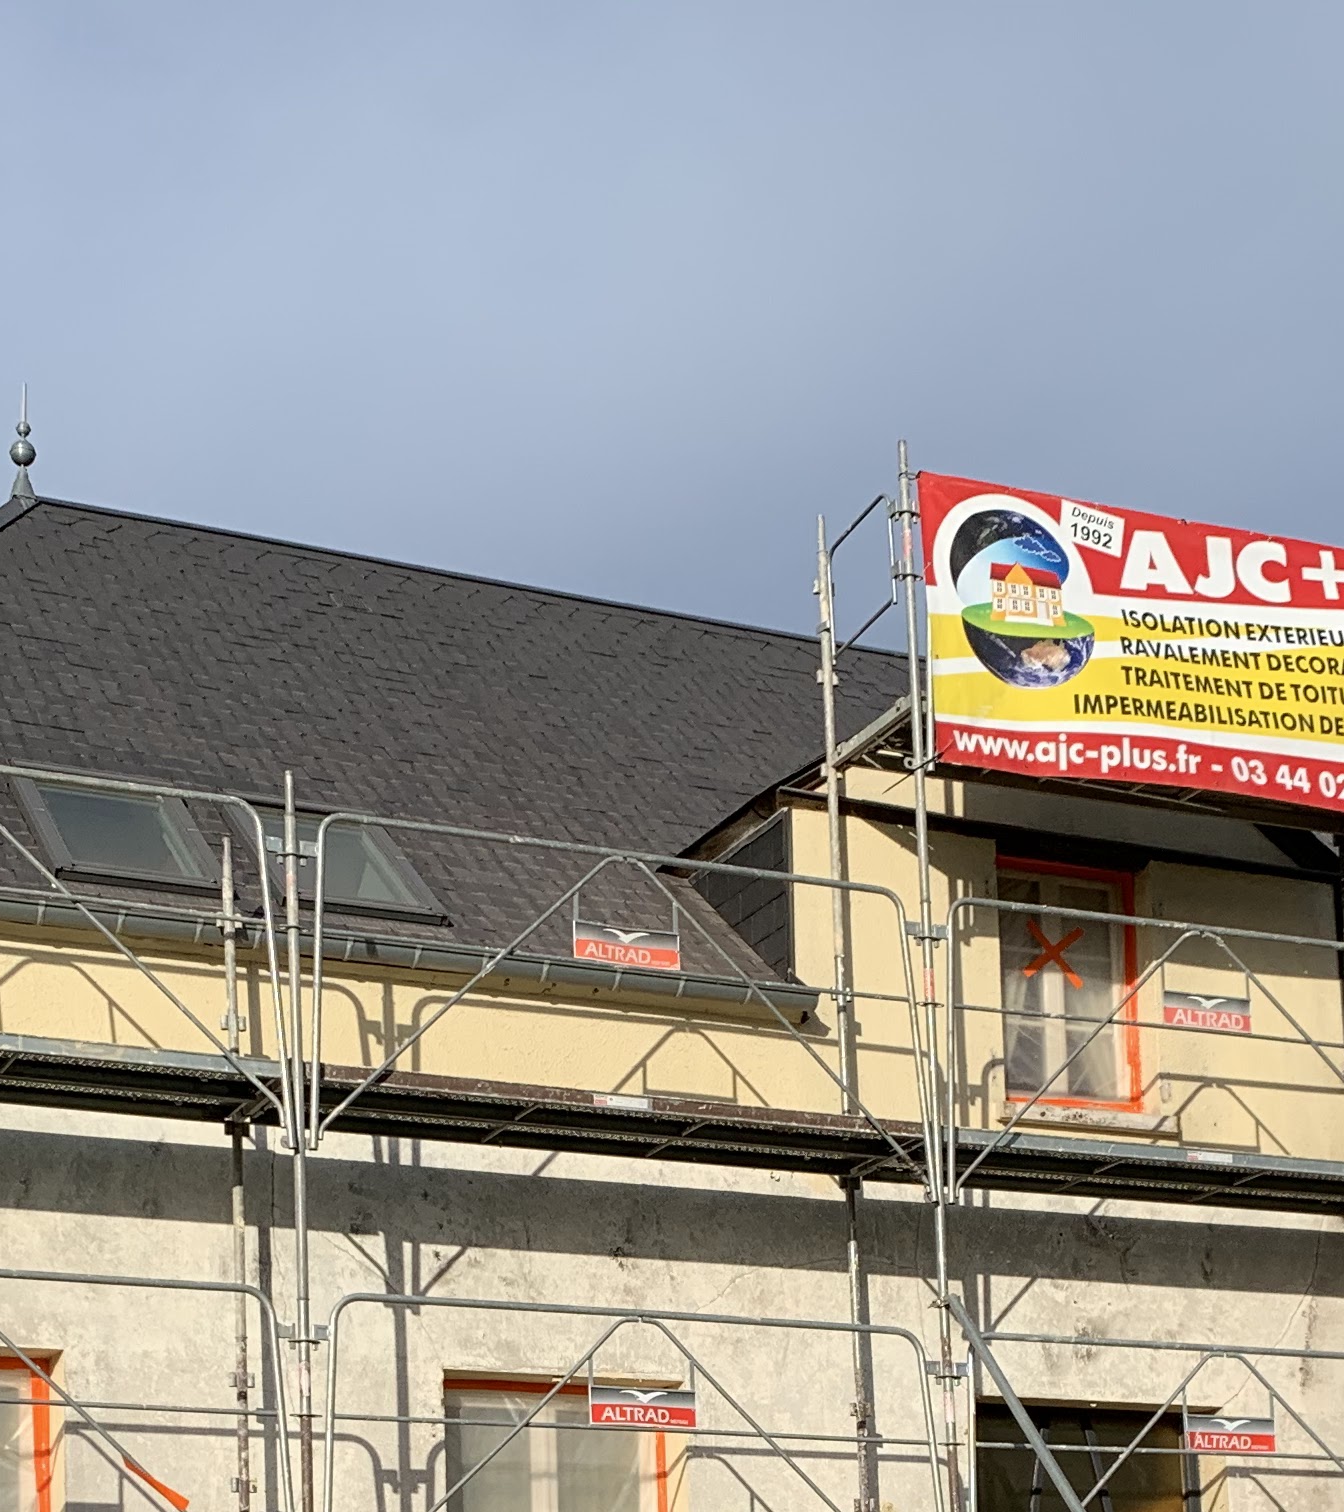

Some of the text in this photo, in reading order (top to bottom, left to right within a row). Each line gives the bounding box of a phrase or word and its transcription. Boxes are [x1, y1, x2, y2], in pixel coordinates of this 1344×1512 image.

[1071, 506, 1115, 530] Depuis
[1070, 522, 1113, 549] 1992
[1121, 608, 1241, 640] ISOLATION
[1119, 636, 1261, 670] RAVALEMENT
[1120, 665, 1253, 699] TRAITEMENT
[1258, 681, 1288, 701] DE
[1073, 693, 1315, 734] IMPERMEABILISATION
[1319, 715, 1344, 737] DE
[953, 729, 1202, 774] www.ajc-plus.fr
[1230, 756, 1268, 785] 03
[1275, 764, 1311, 794] 44
[583, 941, 651, 964] ALTRAD
[1172, 1008, 1244, 1030] ALTRAD
[600, 1406, 670, 1424] ALTRAD
[1193, 1433, 1252, 1450] ALTRAD
